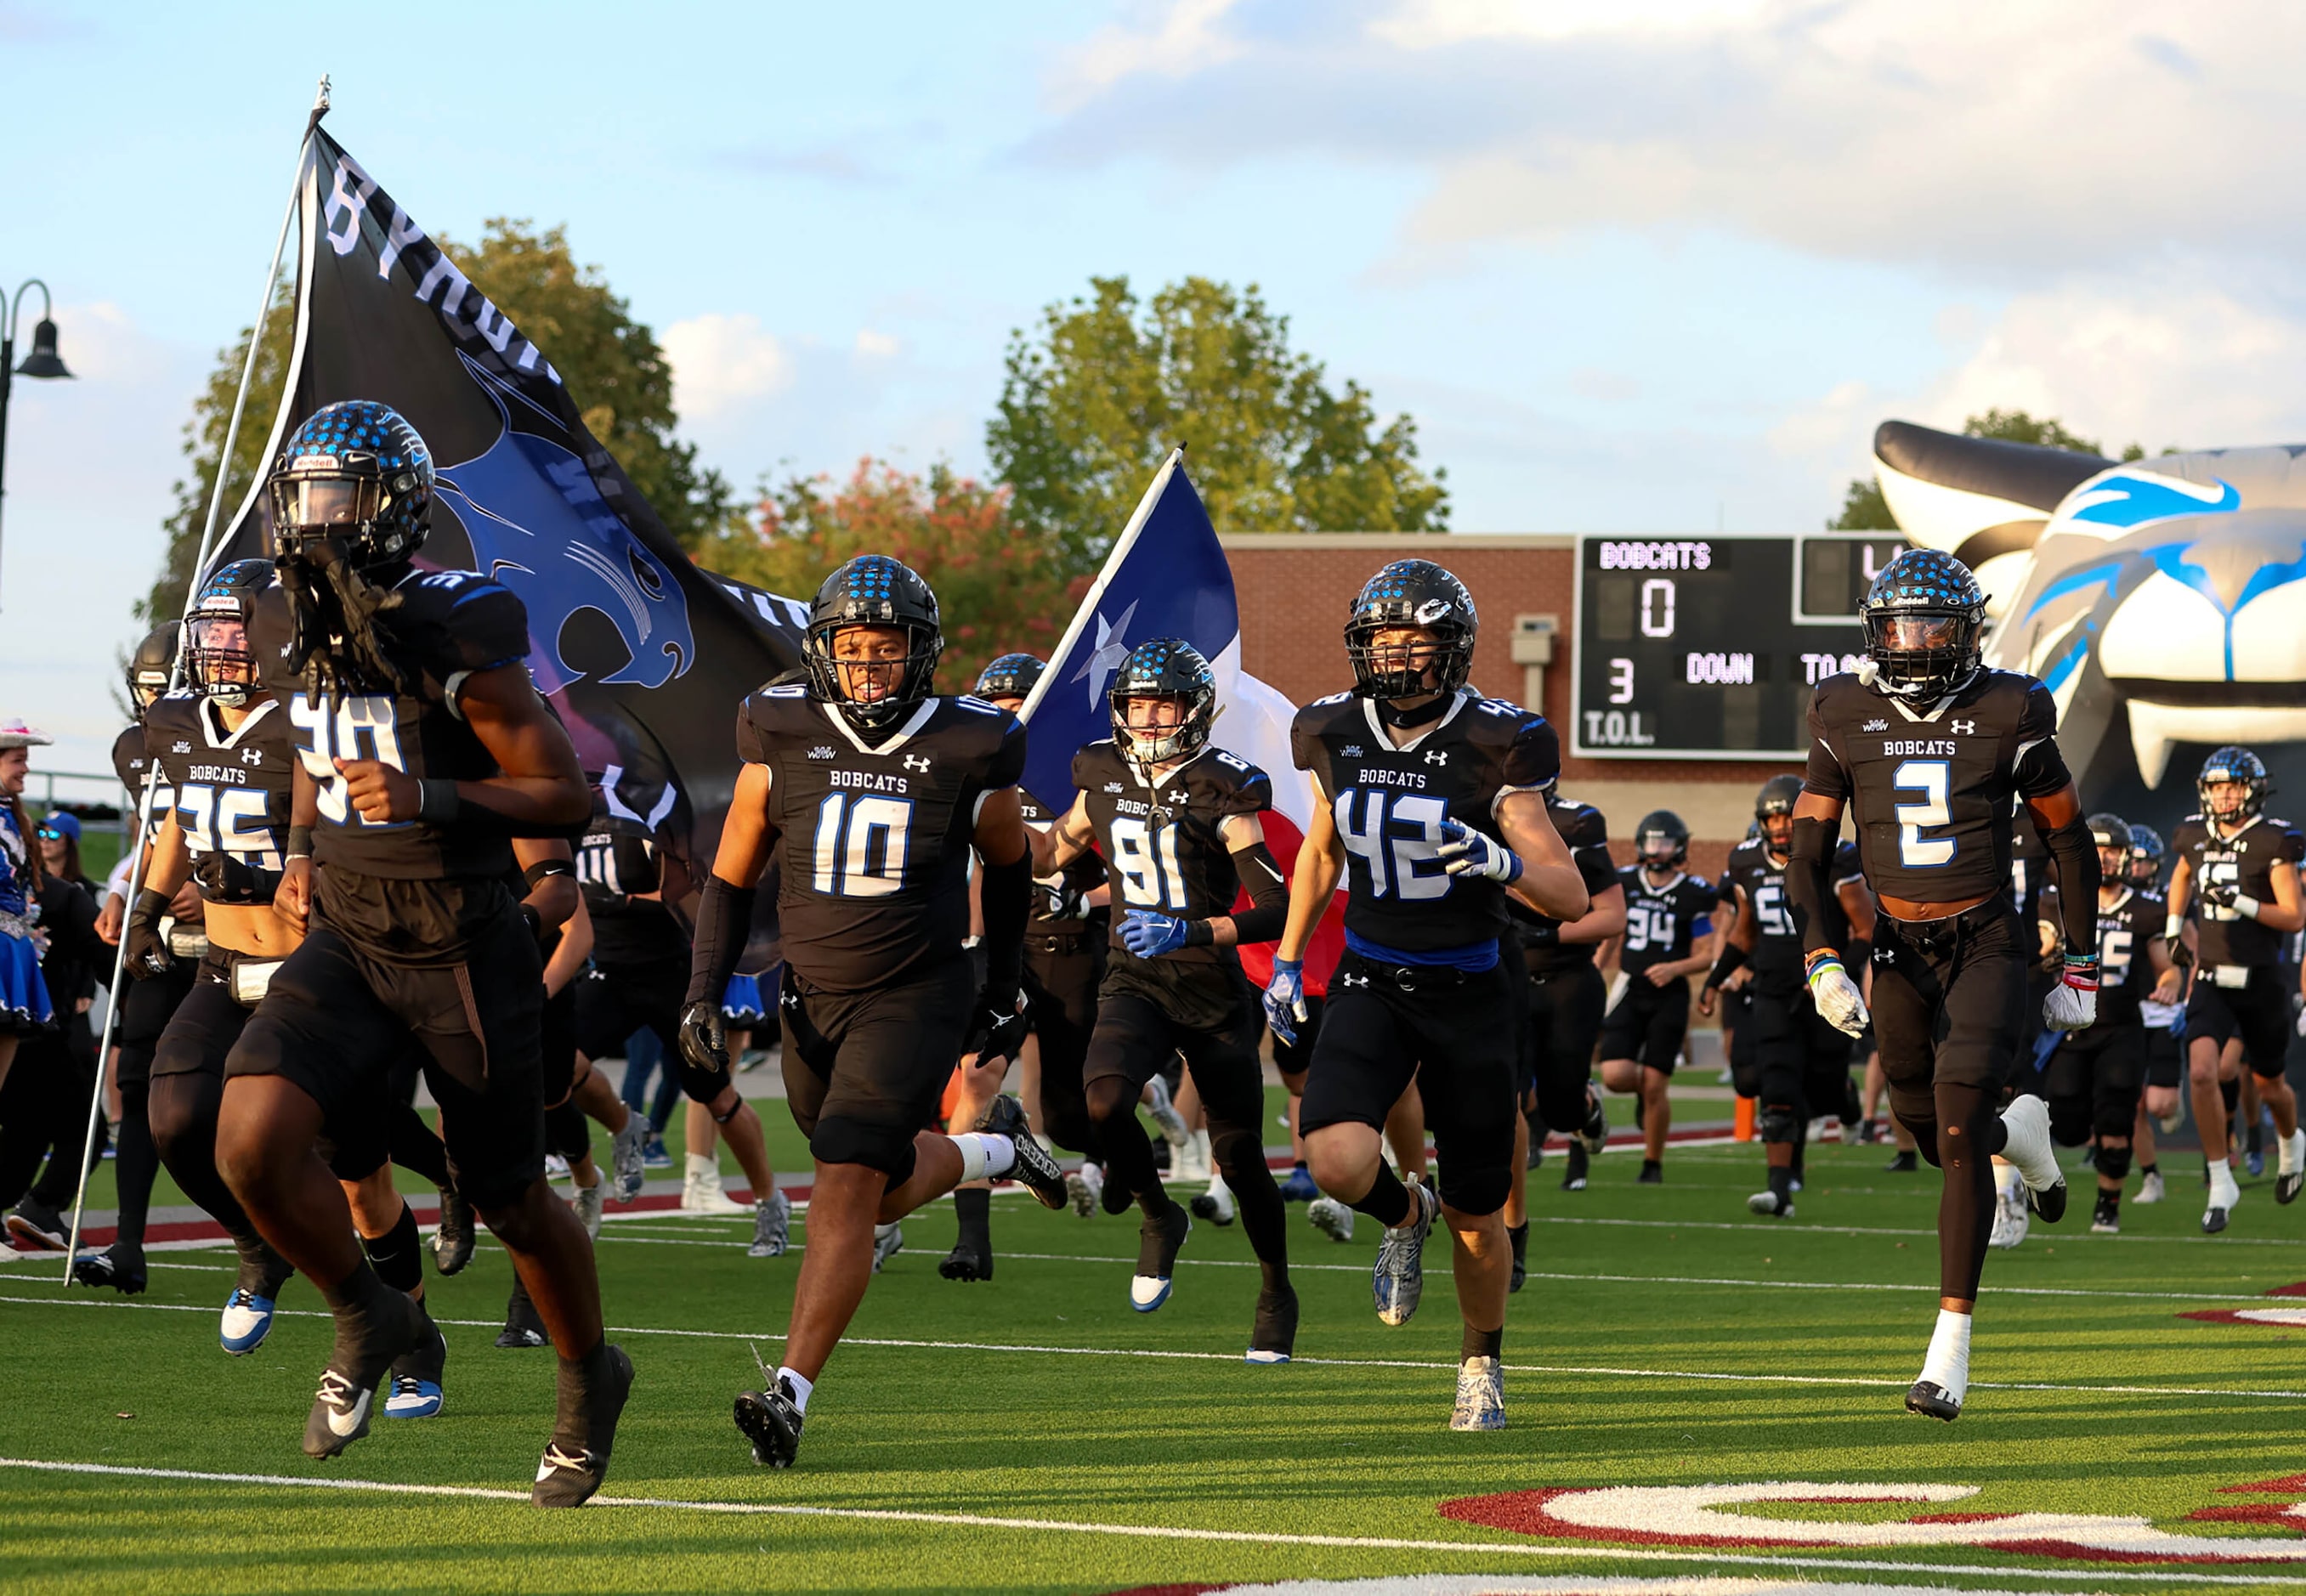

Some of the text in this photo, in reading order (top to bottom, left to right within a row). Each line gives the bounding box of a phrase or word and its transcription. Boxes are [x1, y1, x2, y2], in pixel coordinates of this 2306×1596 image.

[1600, 541, 1711, 570] BOBCATS
[1641, 578, 1675, 637] 0
[1895, 597, 1929, 605] Riddell
[1609, 658, 1635, 704] 3
[1686, 653, 1754, 684] DOWN
[1584, 710, 1655, 744] T.O.L.
[1884, 740, 1956, 756] BOBCATS
[189, 766, 246, 784] BOBCATS
[830, 771, 908, 794] BOBCATS
[1358, 769, 1426, 789] BOBCATS
[1893, 760, 1958, 869] 2
[813, 790, 915, 897] 10
[1335, 787, 1455, 901] 42
[1108, 817, 1188, 911] 81
[2095, 929, 2133, 987] 5
